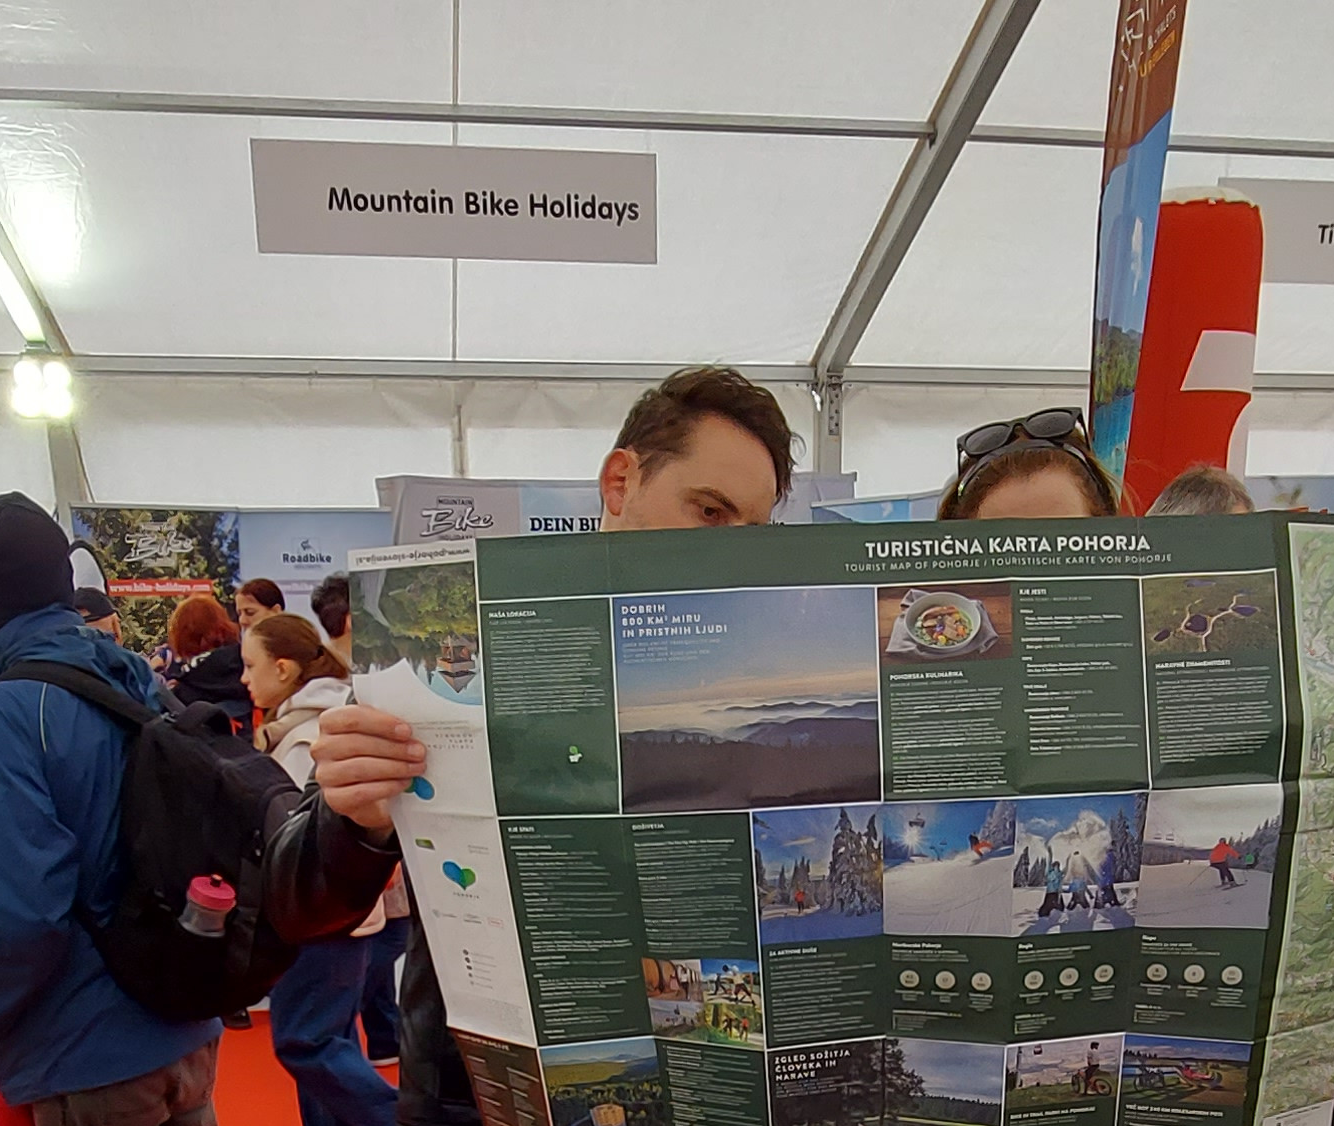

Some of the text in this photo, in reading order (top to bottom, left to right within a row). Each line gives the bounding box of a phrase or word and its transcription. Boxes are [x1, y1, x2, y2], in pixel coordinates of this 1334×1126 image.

[327, 187, 640, 227] Mountain Bike Holidays
[419, 506, 494, 538] Bike
[529, 517, 574, 531] DEIN
[865, 535, 1151, 559] TURISTIČNA KARTA POHORJA
[282, 552, 332, 565] Roadbike
[845, 562, 886, 572] TOURIST
[890, 561, 911, 570] MAP
[915, 561, 928, 569] OF
[932, 558, 980, 569] POHORJE
[991, 557, 1061, 567] TOURISTISCHE
[1065, 556, 1096, 565] KARTE
[1099, 555, 1121, 564] VON
[1131, 553, 1172, 563] POHORJE
[621, 604, 666, 615] DOBRIH
[622, 614, 702, 626] 800 MIRU
[622, 624, 728, 638] IN PRISTNIH LJUDI
[774, 1048, 851, 1065] ZGLED SOŽITJA
[774, 1061, 822, 1074] ČLOVEKA
[775, 1070, 816, 1081] NARAVE
